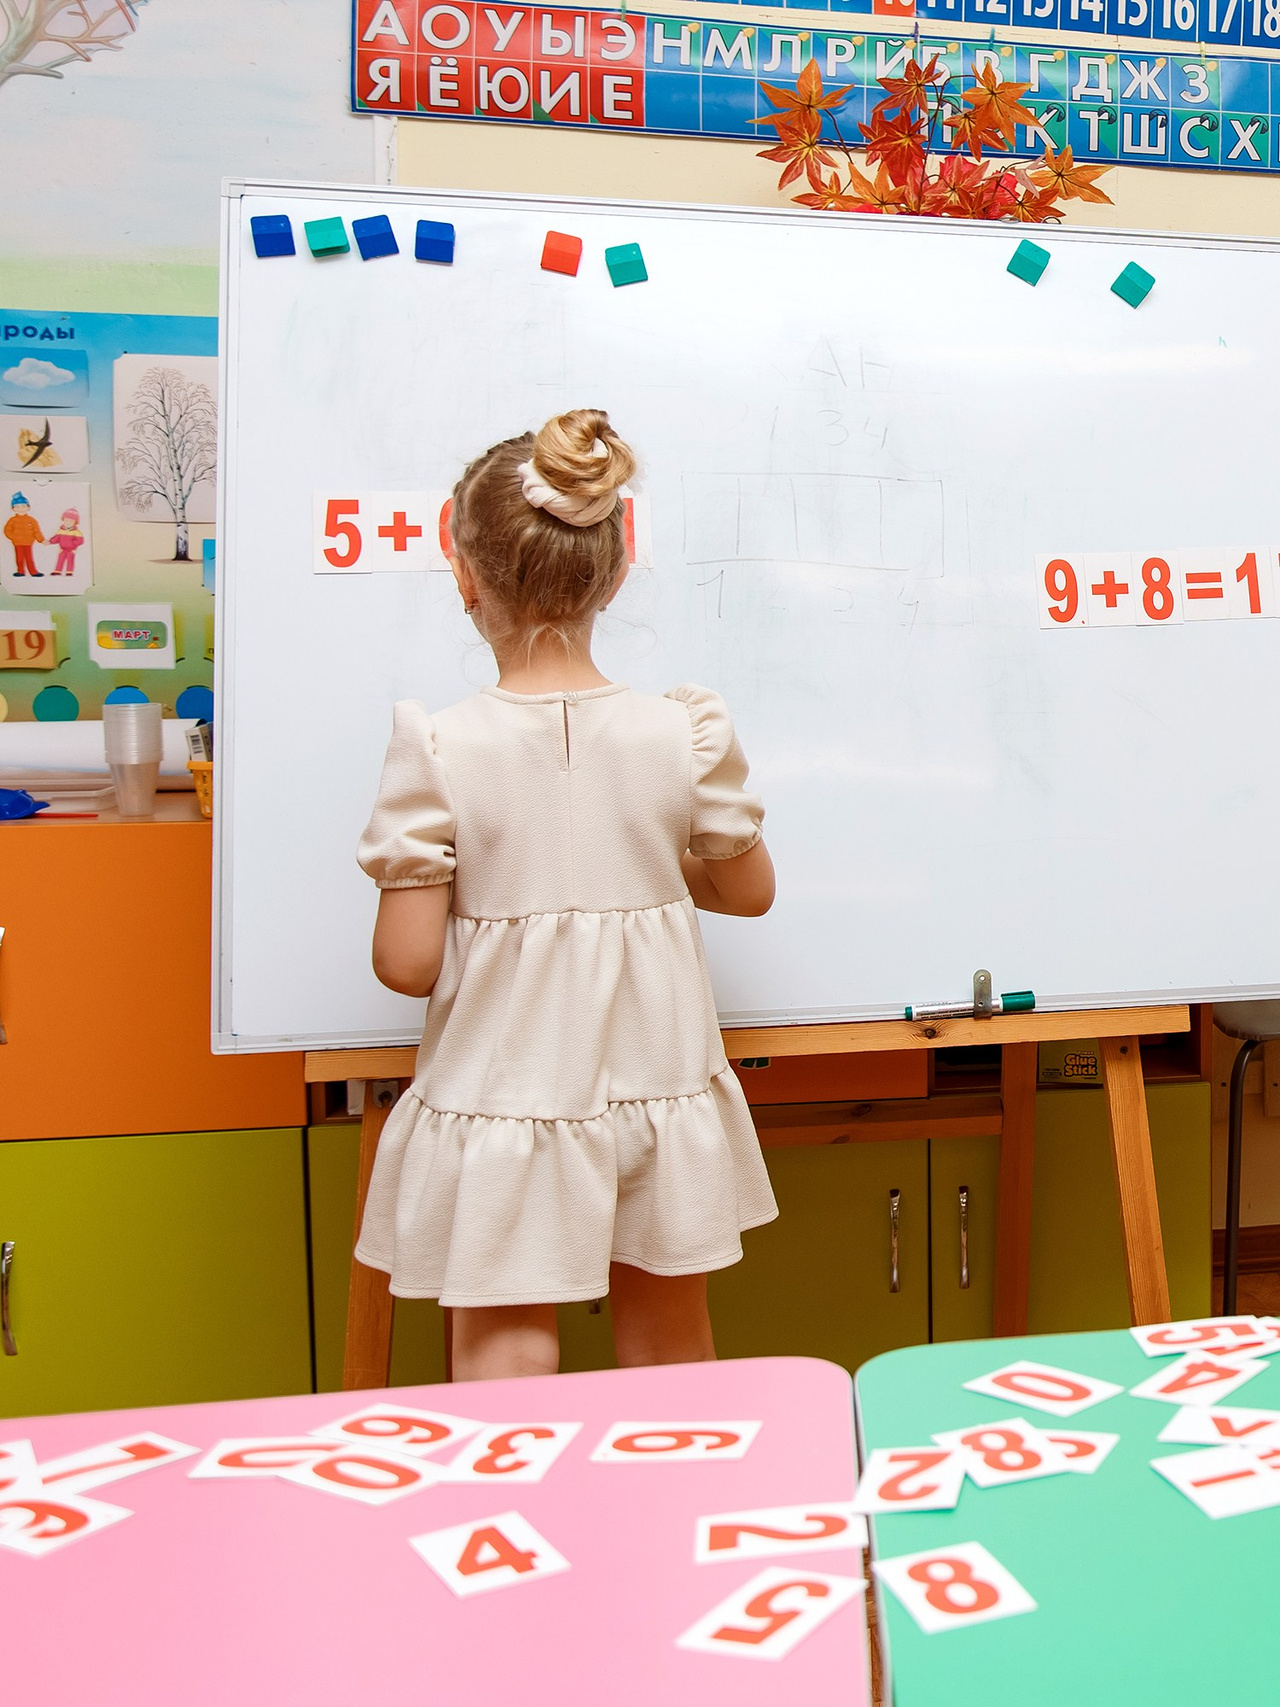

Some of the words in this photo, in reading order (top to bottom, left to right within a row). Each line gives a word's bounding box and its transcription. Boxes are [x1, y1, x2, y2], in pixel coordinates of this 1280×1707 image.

[363, 2, 410, 47] А
[422, 5, 471, 49] О
[481, 11, 524, 52] У
[541, 16, 585, 58] Ы
[600, 18, 637, 61] Э
[653, 22, 692, 66] Н
[704, 28, 753, 71] М
[763, 33, 801, 74] Л
[826, 38, 856, 77] Р
[922, 46, 950, 87] Б
[1030, 53, 1057, 92] Г
[1071, 57, 1113, 103] Д
[1121, 59, 1167, 101] Ж
[1179, 64, 1210, 103] З
[365, 58, 402, 103] Я
[428, 56, 460, 107] Ё
[478, 65, 530, 112] Ю
[540, 71, 580, 116] И
[602, 75, 634, 120] Е
[1025, 107, 1060, 149] К
[1078, 111, 1111, 152] Т
[1122, 114, 1167, 155] Ш
[1180, 118, 1211, 159] С
[1227, 120, 1263, 162] Х
[0, 324, 75, 341] роды
[3, 630, 46, 661] 19
[112, 630, 150, 641] МАРТ
[1064, 1065, 1098, 1077] Stick
[1065, 1053, 1097, 1065] Glue
[992, 1372, 1092, 1402] 0
[472, 1427, 557, 1475] 3
[961, 1429, 1043, 1472] 8
[311, 1455, 421, 1490] 0
[877, 1451, 951, 1501] 2
[456, 1525, 539, 1577] 4
[708, 1513, 848, 1552] 2
[906, 1558, 1000, 1615] 8
[709, 1580, 830, 1645] 5
